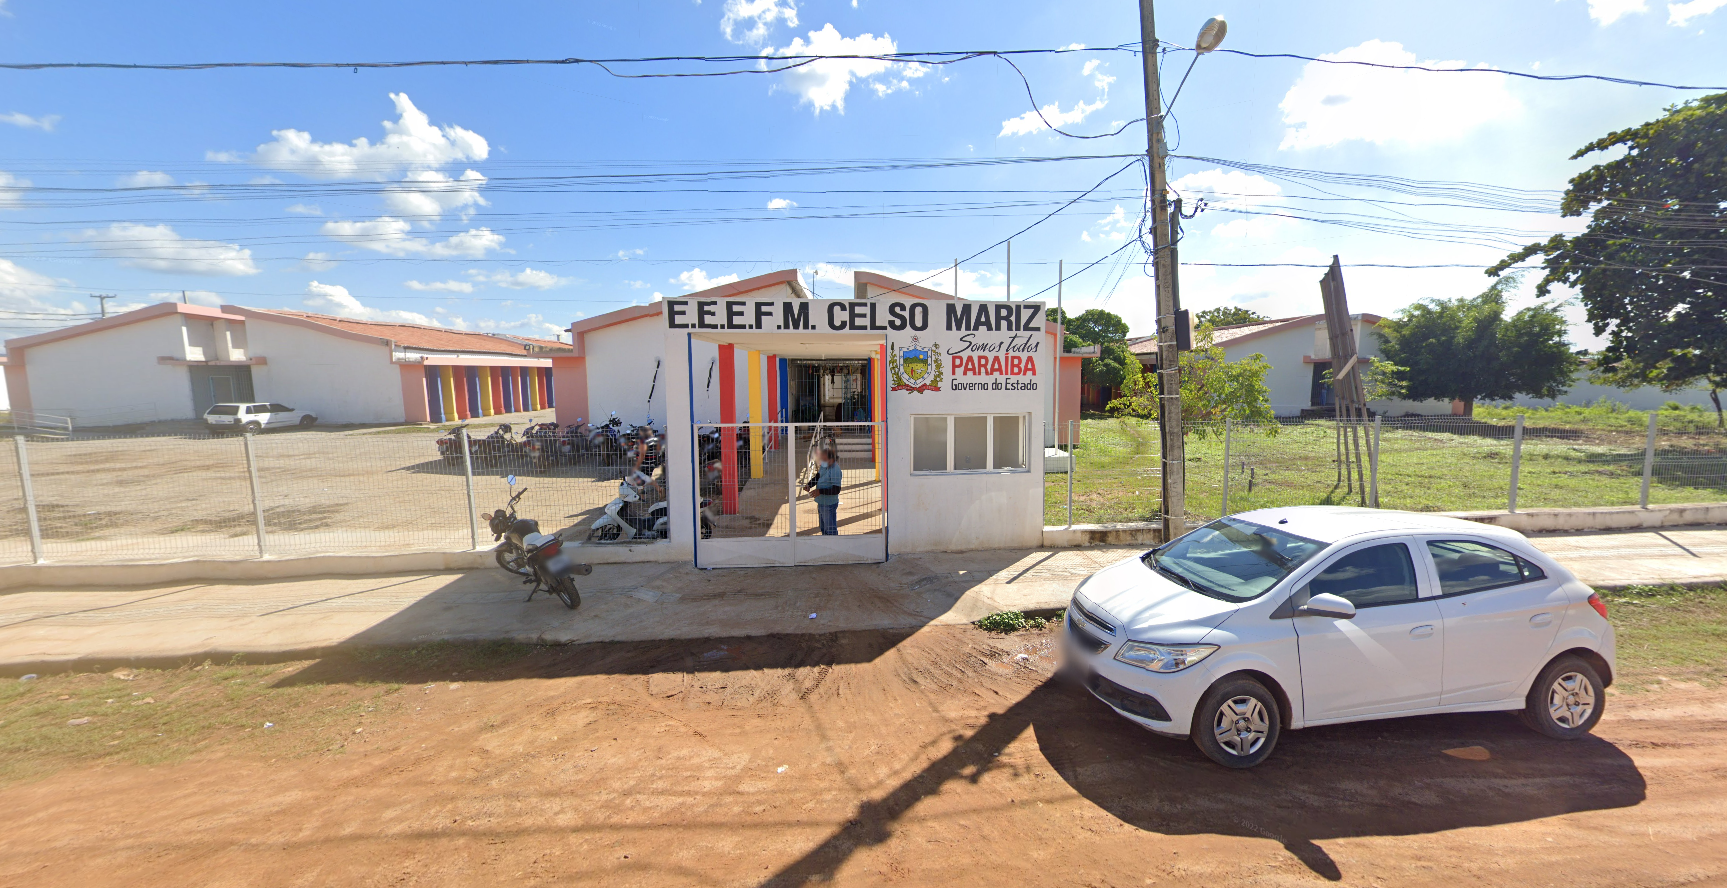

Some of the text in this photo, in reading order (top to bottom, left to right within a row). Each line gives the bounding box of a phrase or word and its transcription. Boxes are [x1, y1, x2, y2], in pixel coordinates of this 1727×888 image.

[667, 300, 1041, 332] E.E.E.F.M. CELSO MARIZ
[947, 333, 1040, 355] Somos todos
[951, 353, 1037, 376] PARAÍBA
[951, 378, 989, 391] Governo
[991, 378, 1003, 391] do
[1004, 378, 1038, 391] Estado
